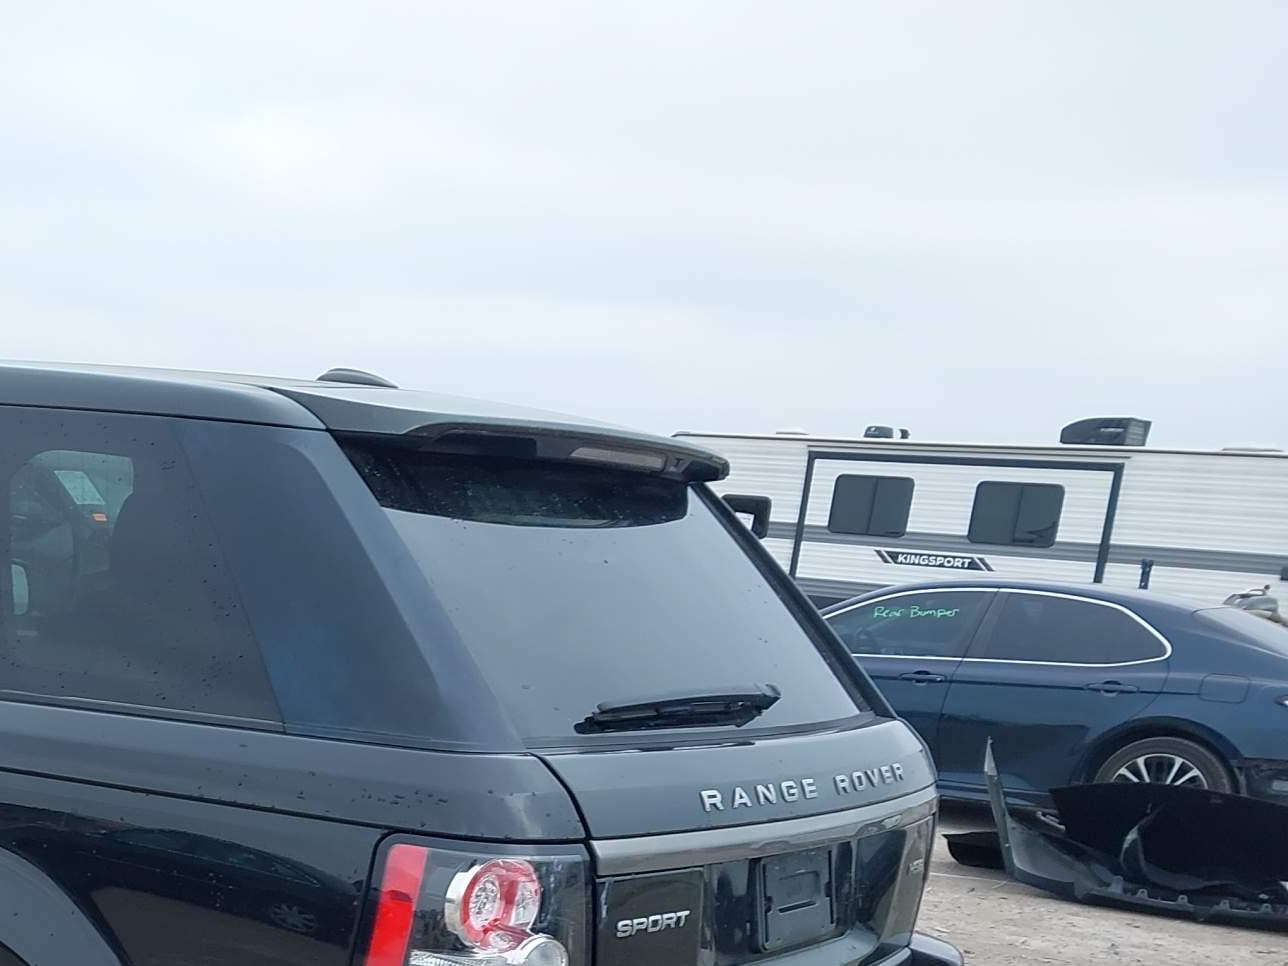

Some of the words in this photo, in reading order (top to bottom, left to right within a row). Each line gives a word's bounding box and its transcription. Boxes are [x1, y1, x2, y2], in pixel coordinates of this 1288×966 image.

[897, 553, 972, 569] KINGSPORT
[873, 606, 905, 618] Rear
[910, 605, 960, 618] Bumper
[699, 777, 818, 813] RANGE
[832, 762, 905, 796] ROVER
[615, 910, 691, 938] SPORT
